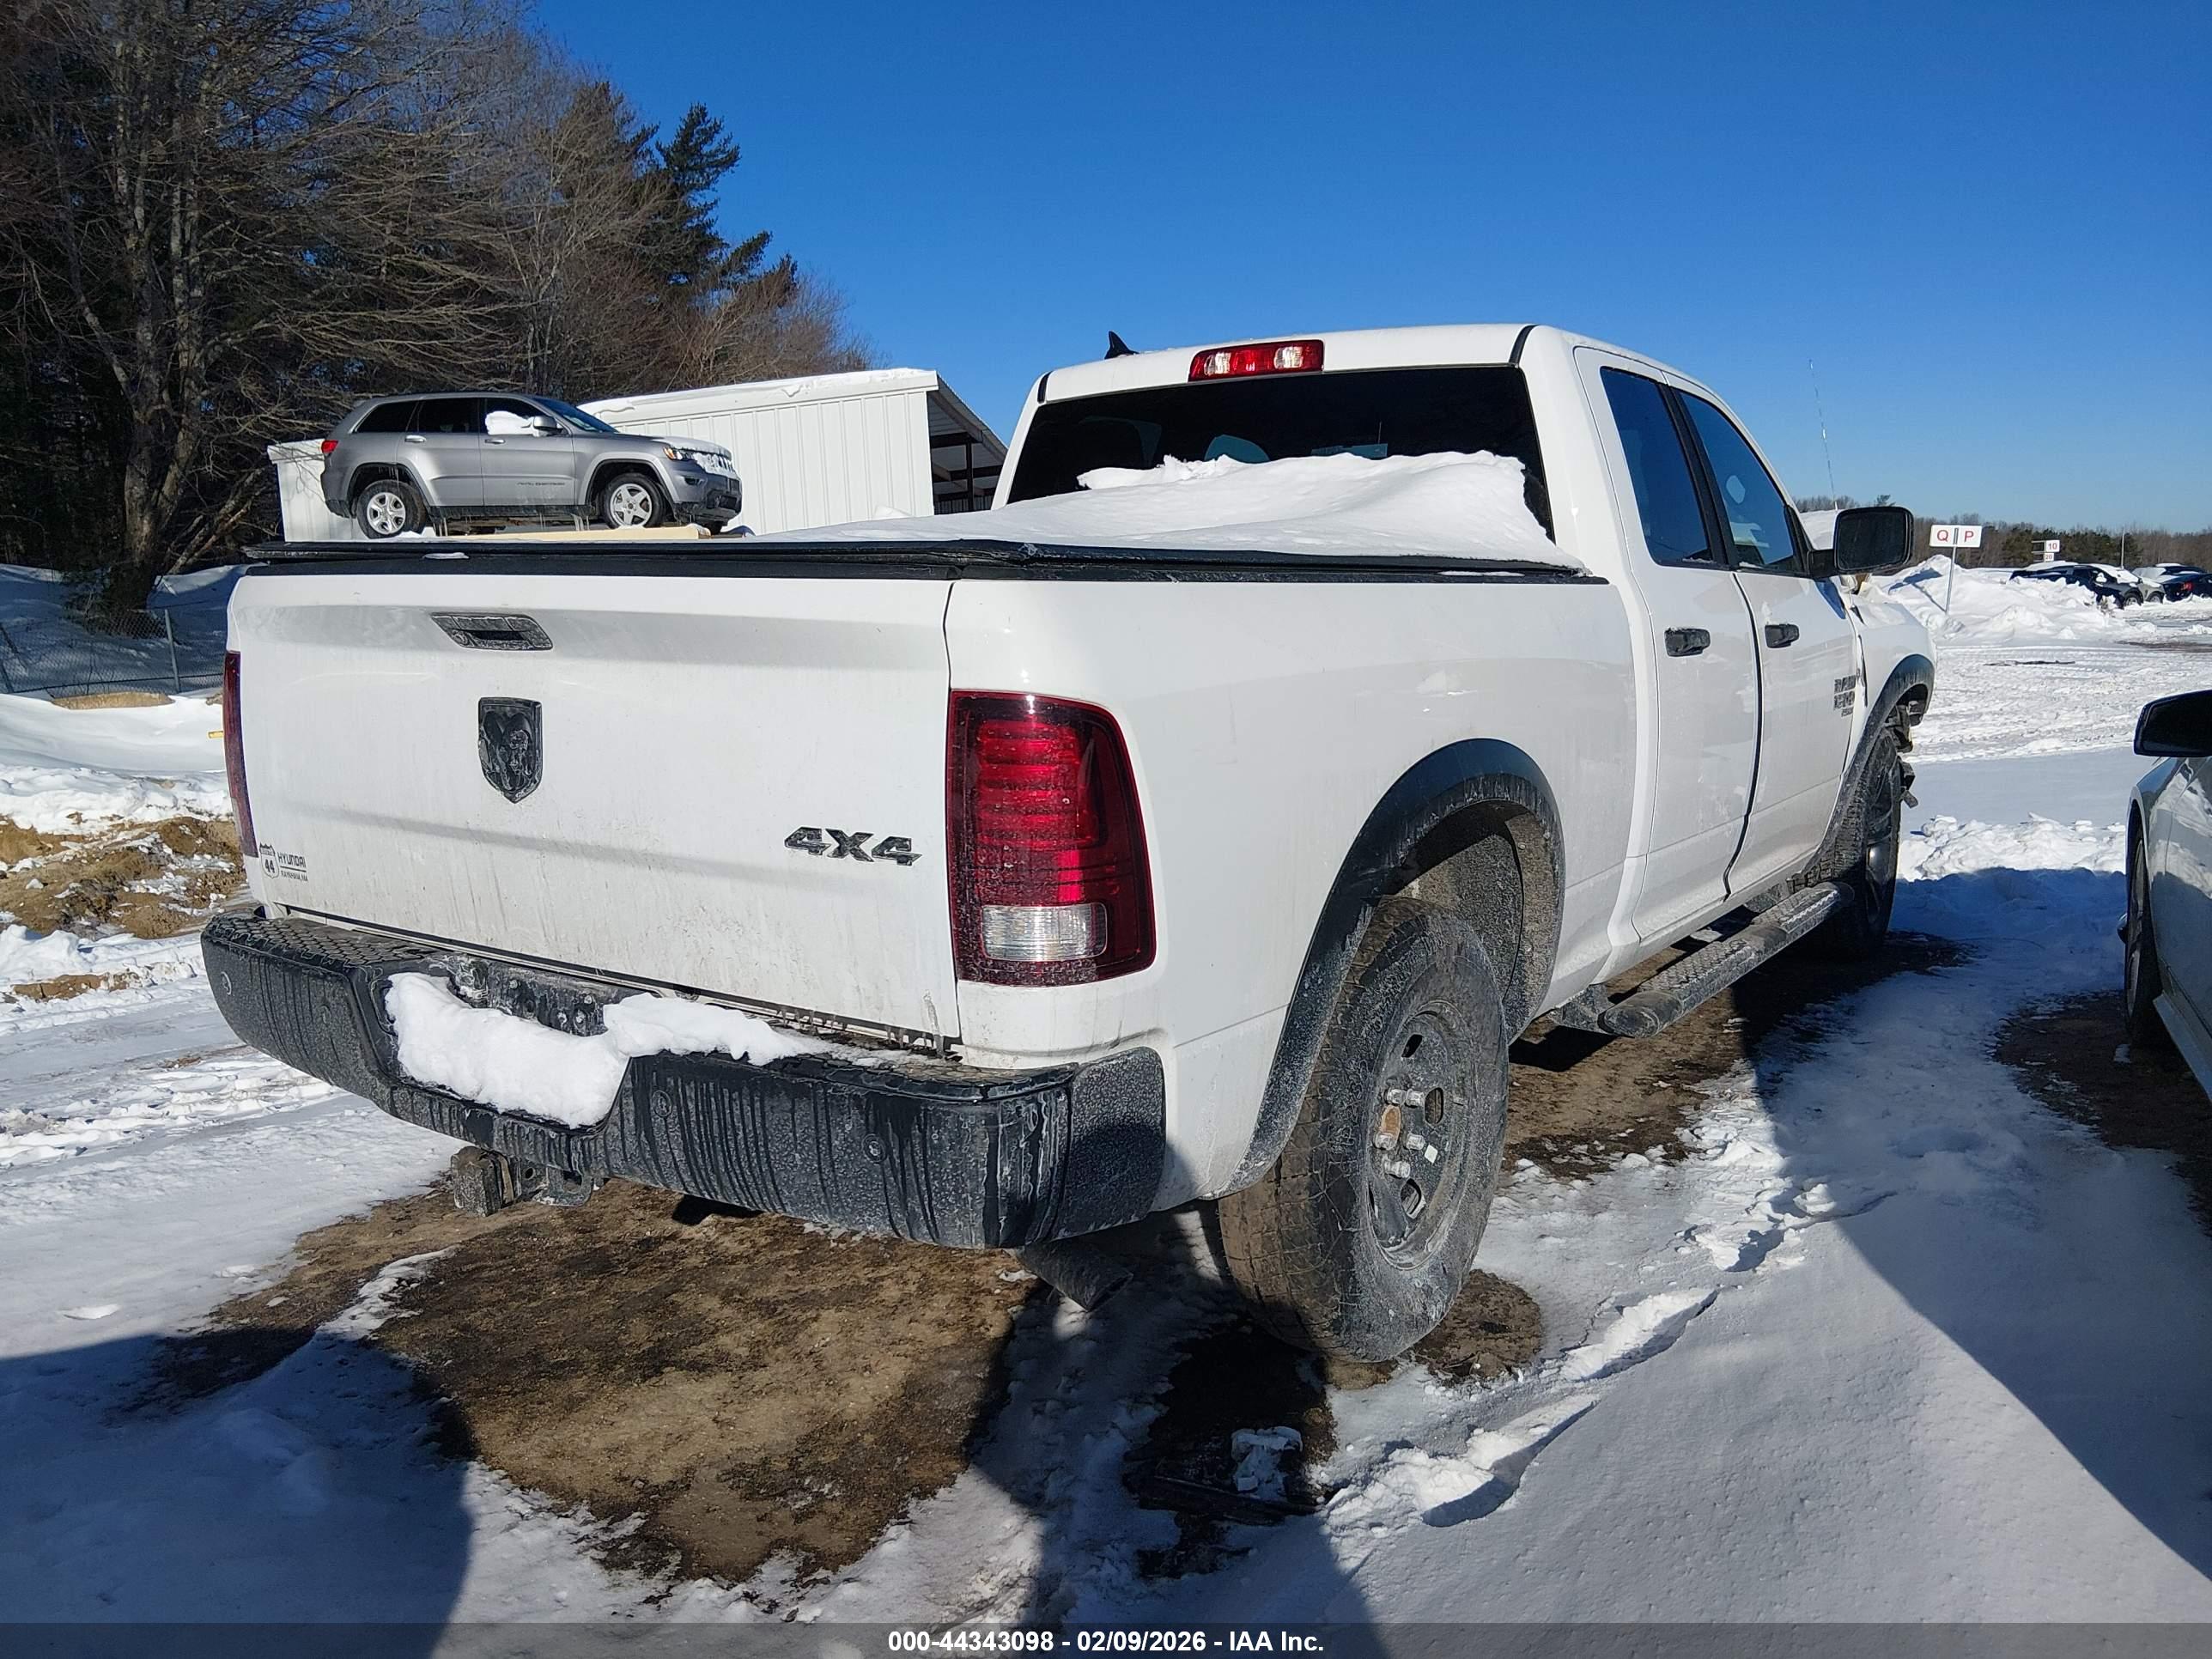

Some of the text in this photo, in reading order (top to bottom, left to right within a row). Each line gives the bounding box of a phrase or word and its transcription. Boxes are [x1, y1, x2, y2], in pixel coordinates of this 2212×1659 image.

[1936, 529, 1974, 542] Q P
[264, 859, 275, 873] 44
[277, 852, 307, 868] HYUNDAI
